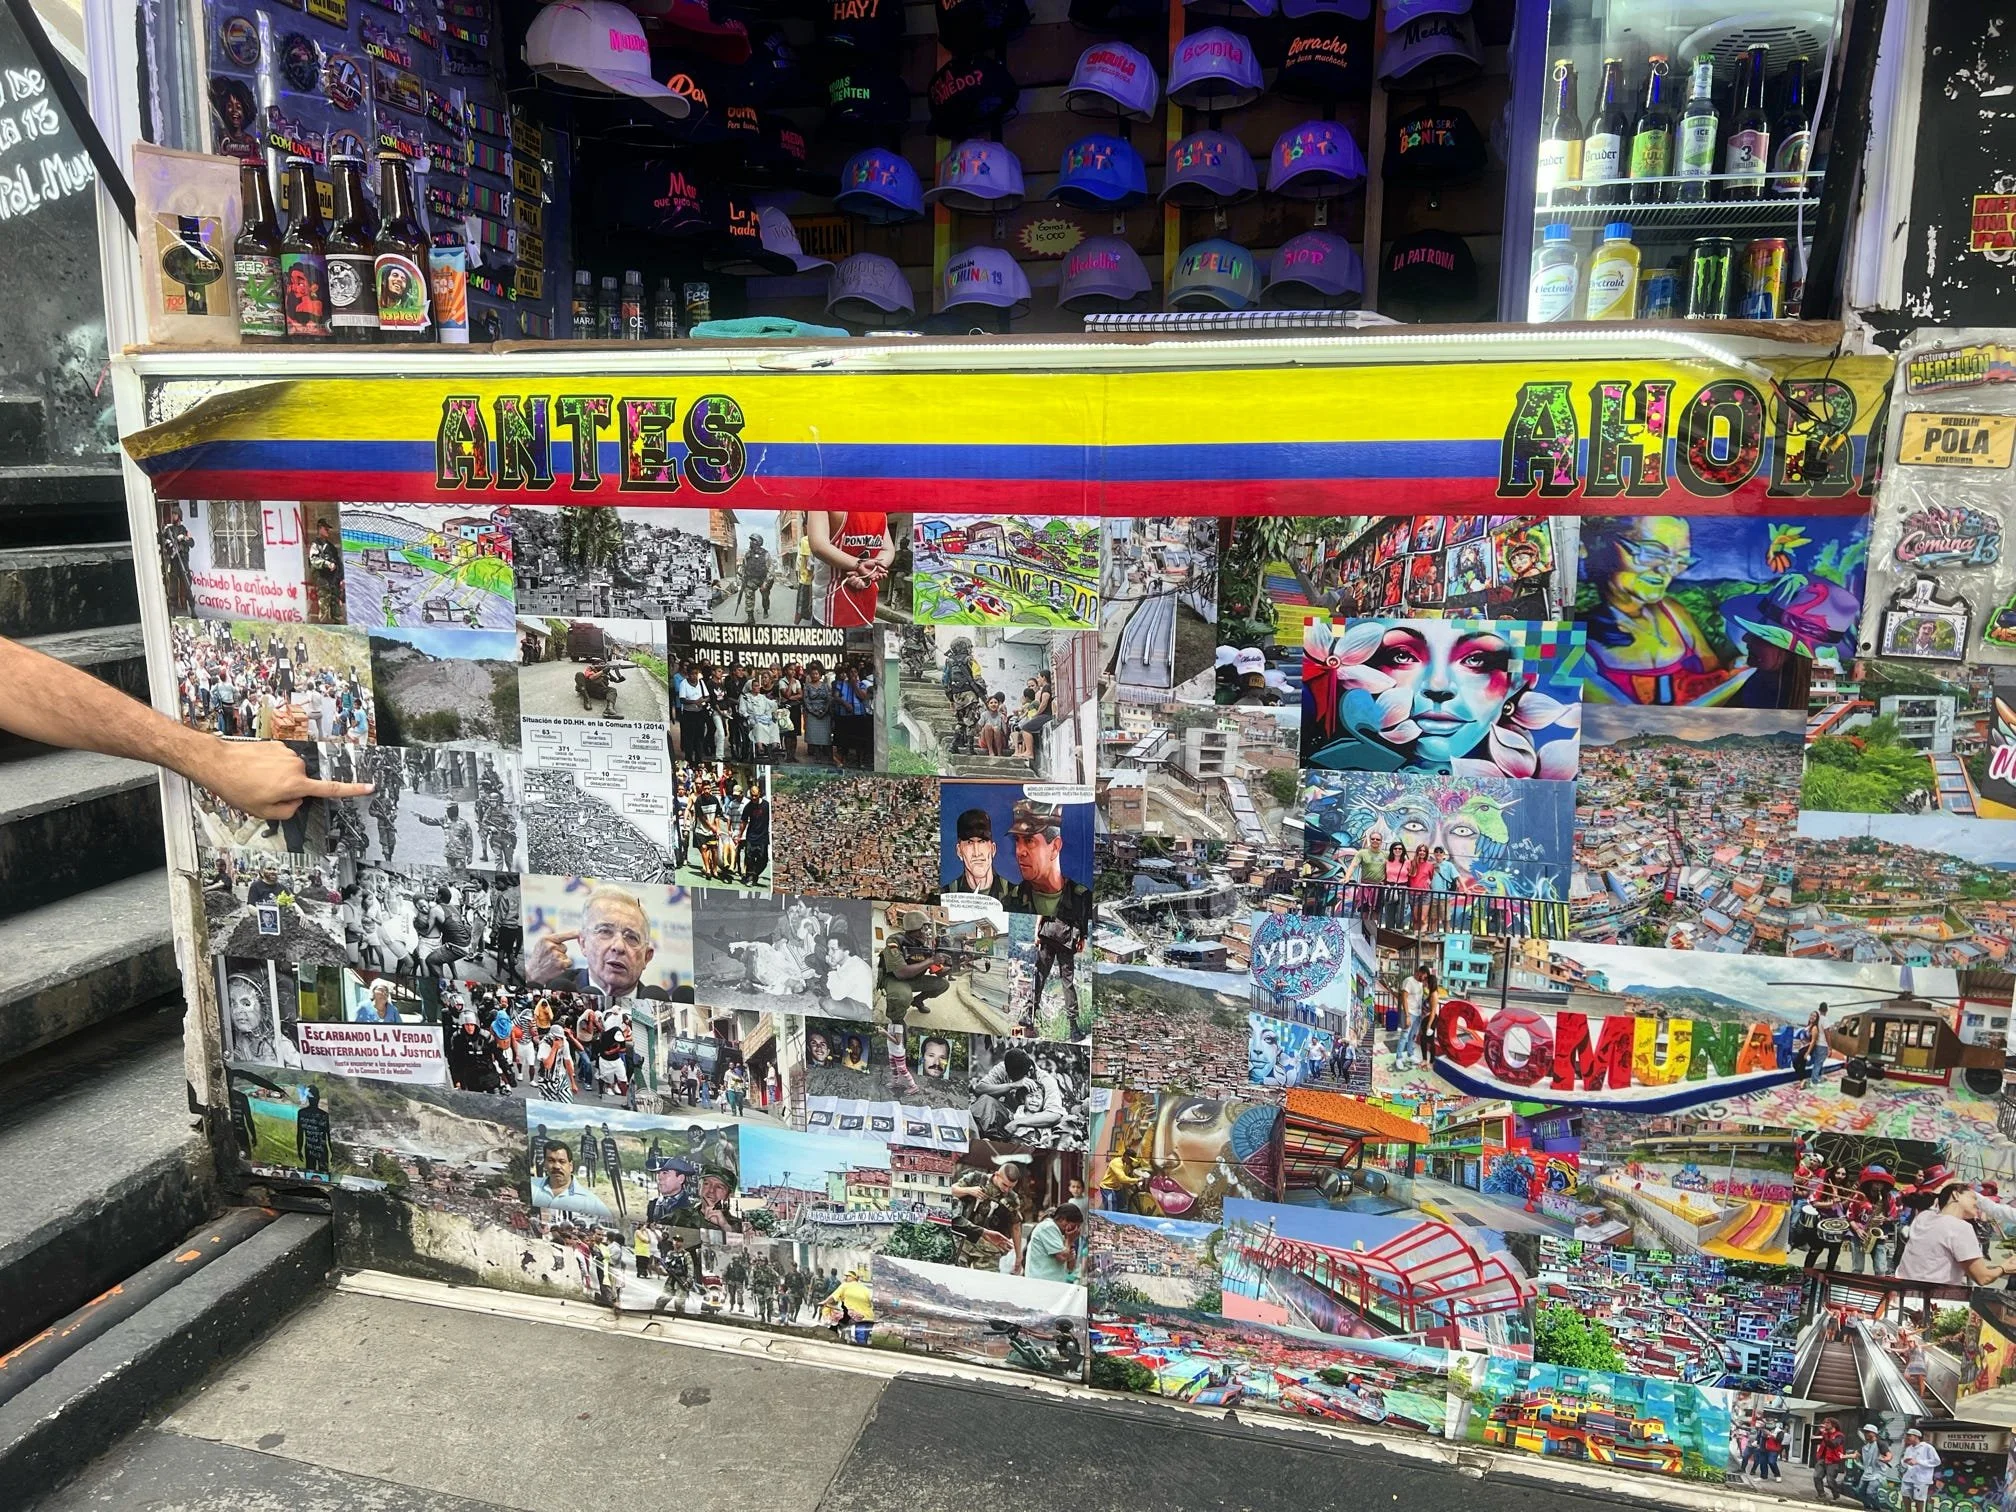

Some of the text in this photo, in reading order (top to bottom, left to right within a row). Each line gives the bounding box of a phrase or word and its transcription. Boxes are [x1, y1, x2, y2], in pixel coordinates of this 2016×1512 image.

[367, 43, 401, 65] COMUNA
[1288, 35, 1348, 56] Borracho
[22, 98, 60, 141] 13
[271, 134, 311, 157] COMUNA
[380, 134, 413, 156] COMUNA
[1741, 146, 1752, 161] 3
[730, 201, 745, 220] La
[730, 223, 757, 237] nada
[1973, 214, 2008, 231] UNA
[1393, 248, 1455, 272] LA PATRONA
[992, 270, 1003, 285] 13
[1918, 350, 1962, 362] estuve en
[434, 393, 748, 495] ANTES
[1923, 427, 1990, 455] POLA
[1896, 530, 2000, 565] Comuna 13
[691, 624, 844, 647] DONDE ESTAN LOS DESAPARECIDOS
[522, 716, 552, 724] Situación
[563, 718, 586, 726] DD.HH.
[605, 721, 632, 729] Comuna
[633, 722, 642, 730] 13
[643, 723, 665, 731] (2014)
[1258, 936, 1333, 967] VIDA
[304, 1025, 433, 1044] ESCARBANDO LA VERDAD
[300, 1039, 441, 1059] DESENTERRANDO LA JUSTICIA
[1437, 1000, 1778, 1091] COMUNA
[868, 1211, 884, 1221] NOS
[1943, 1441, 1989, 1451] COMUNA 13
